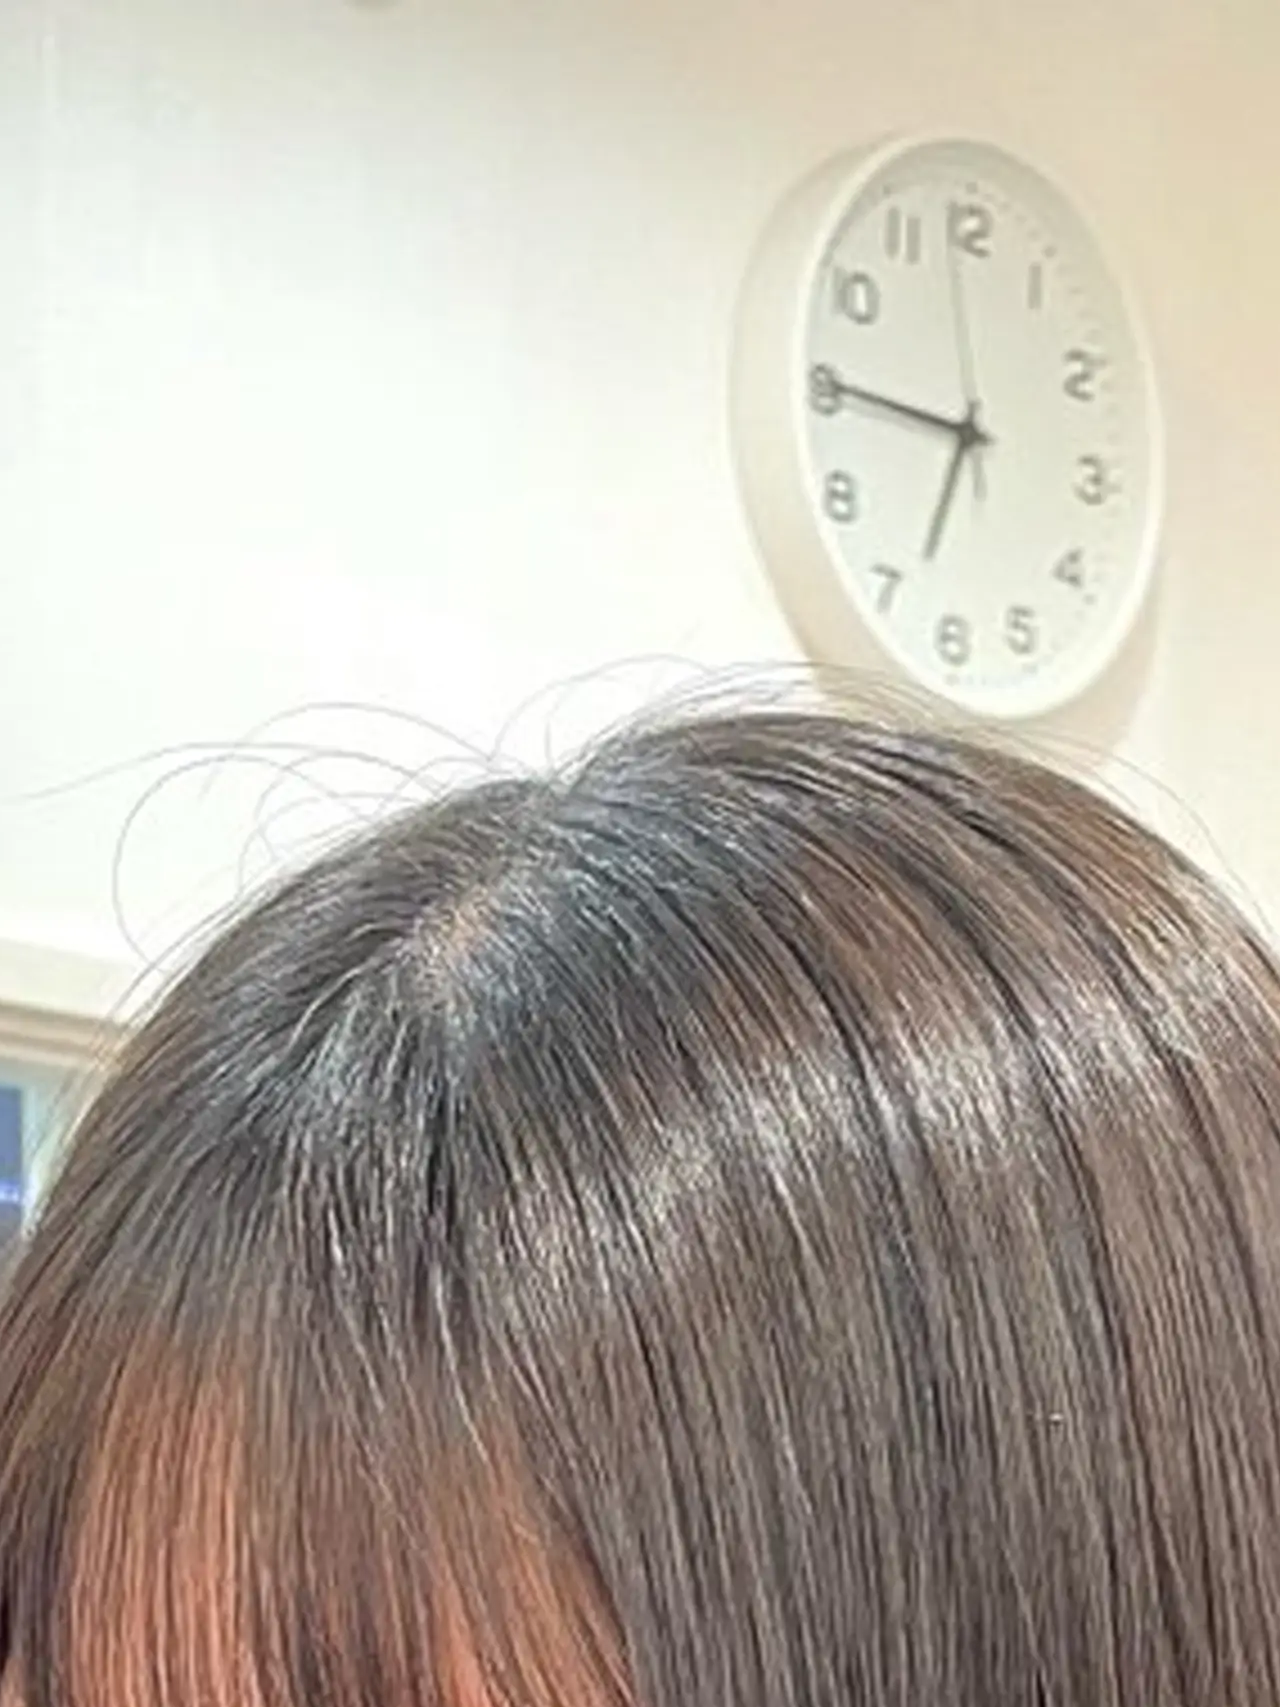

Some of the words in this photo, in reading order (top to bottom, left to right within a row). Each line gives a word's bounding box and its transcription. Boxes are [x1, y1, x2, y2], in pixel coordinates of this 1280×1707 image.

[884, 206, 921, 264] 11
[1062, 348, 1097, 402] 2
[824, 469, 858, 525] 8
[1073, 456, 1108, 506] 3
[870, 564, 902, 614] 7
[1050, 547, 1084, 588] 4
[933, 614, 971, 667] 6
[1004, 605, 1038, 655] 5
